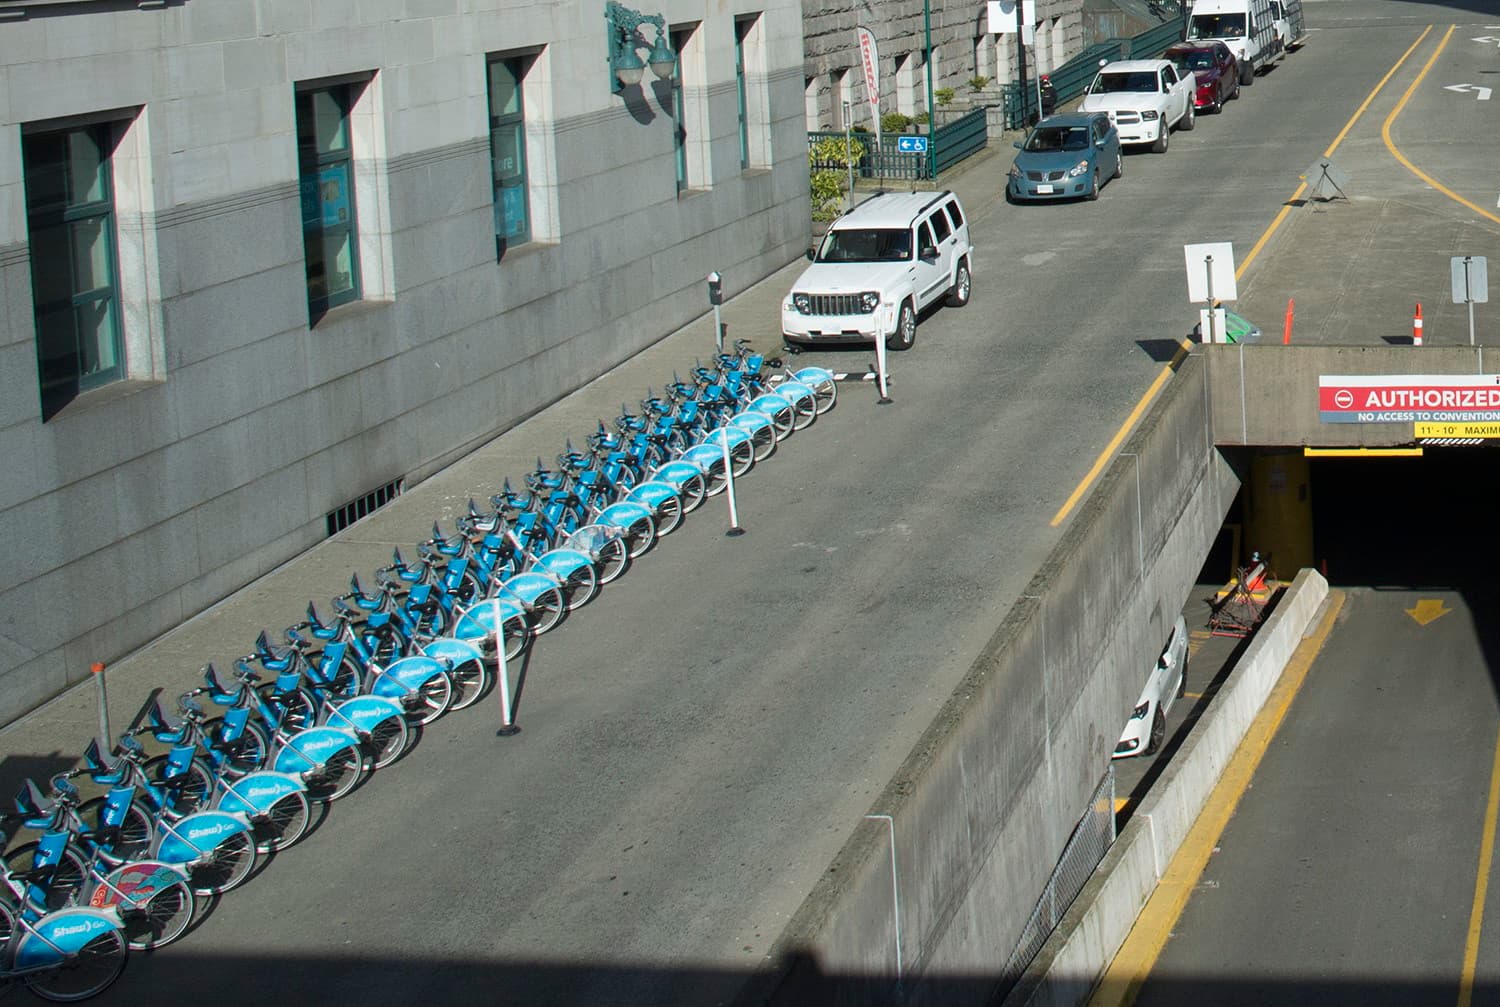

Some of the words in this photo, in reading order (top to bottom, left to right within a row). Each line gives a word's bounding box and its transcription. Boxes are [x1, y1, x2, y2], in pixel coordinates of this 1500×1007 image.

[1358, 413, 1374, 422] NO
[1377, 412, 1414, 421] ACCESS
[1416, 412, 1430, 421] TO
[1432, 412, 1500, 421] CONVENTION
